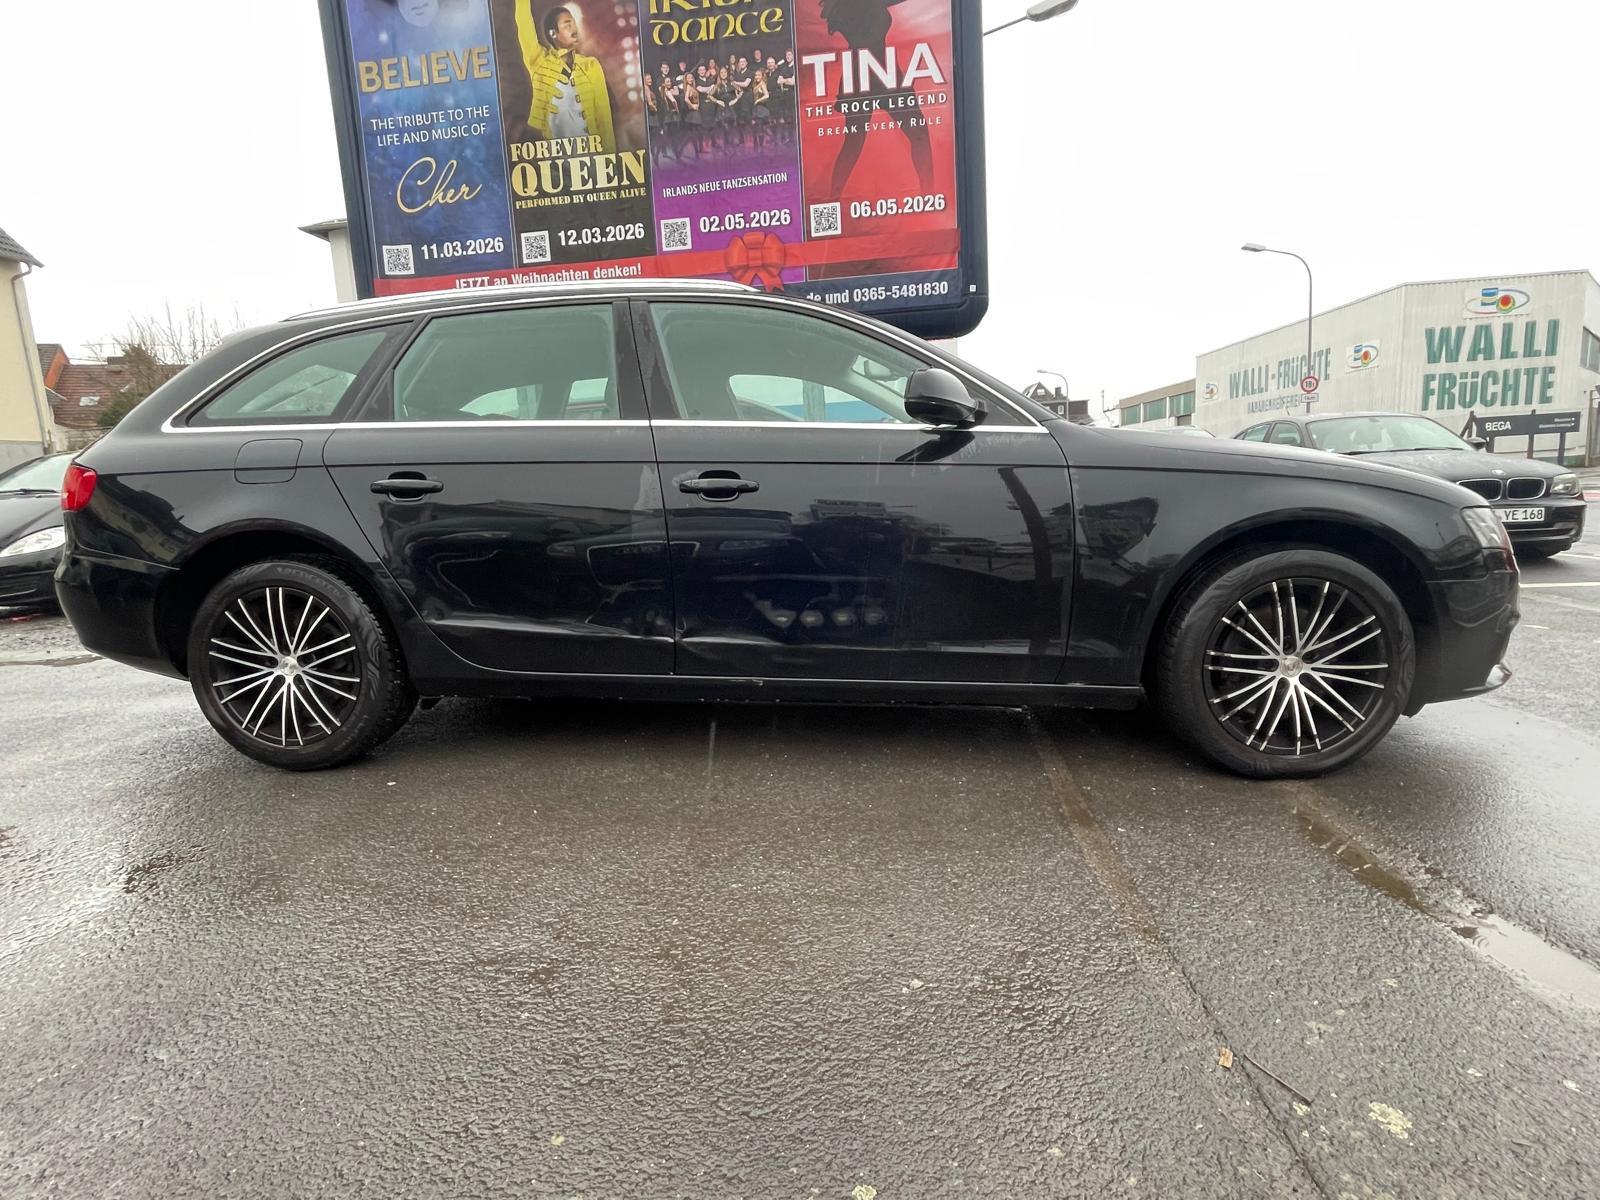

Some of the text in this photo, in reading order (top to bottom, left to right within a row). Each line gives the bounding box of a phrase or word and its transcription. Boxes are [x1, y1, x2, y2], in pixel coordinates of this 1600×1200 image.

[358, 46, 492, 93] BELIEVE
[802, 42, 945, 97] TINA
[805, 93, 947, 117] THE ROCK LEGEND
[370, 105, 490, 131] THE TRIBUTE TO THE
[377, 123, 487, 147] LIFE AND MUSIC OF
[510, 134, 603, 161] FOREVER
[397, 156, 482, 213] Cher
[512, 149, 646, 197] QUEEN
[663, 172, 788, 198] IRLANDS NEUE TANZSENSATION
[516, 187, 646, 209] PERFORMED BY QUEEN ALIVE
[850, 193, 945, 218] 06.05.2026
[699, 208, 791, 233] 02.05.2026
[558, 222, 645, 246] 12.03.2026
[421, 236, 504, 260] 11.03.2026
[511, 269, 589, 284] Weihnachten
[593, 263, 642, 279] denken!
[826, 289, 849, 304] und
[853, 281, 949, 303] 0365-5481830
[1425, 319, 1560, 364] WALLI
[1421, 366, 1556, 411] FRÜCHTE
[1485, 421, 1512, 431] BEGA
[1521, 509, 1543, 520] 168
